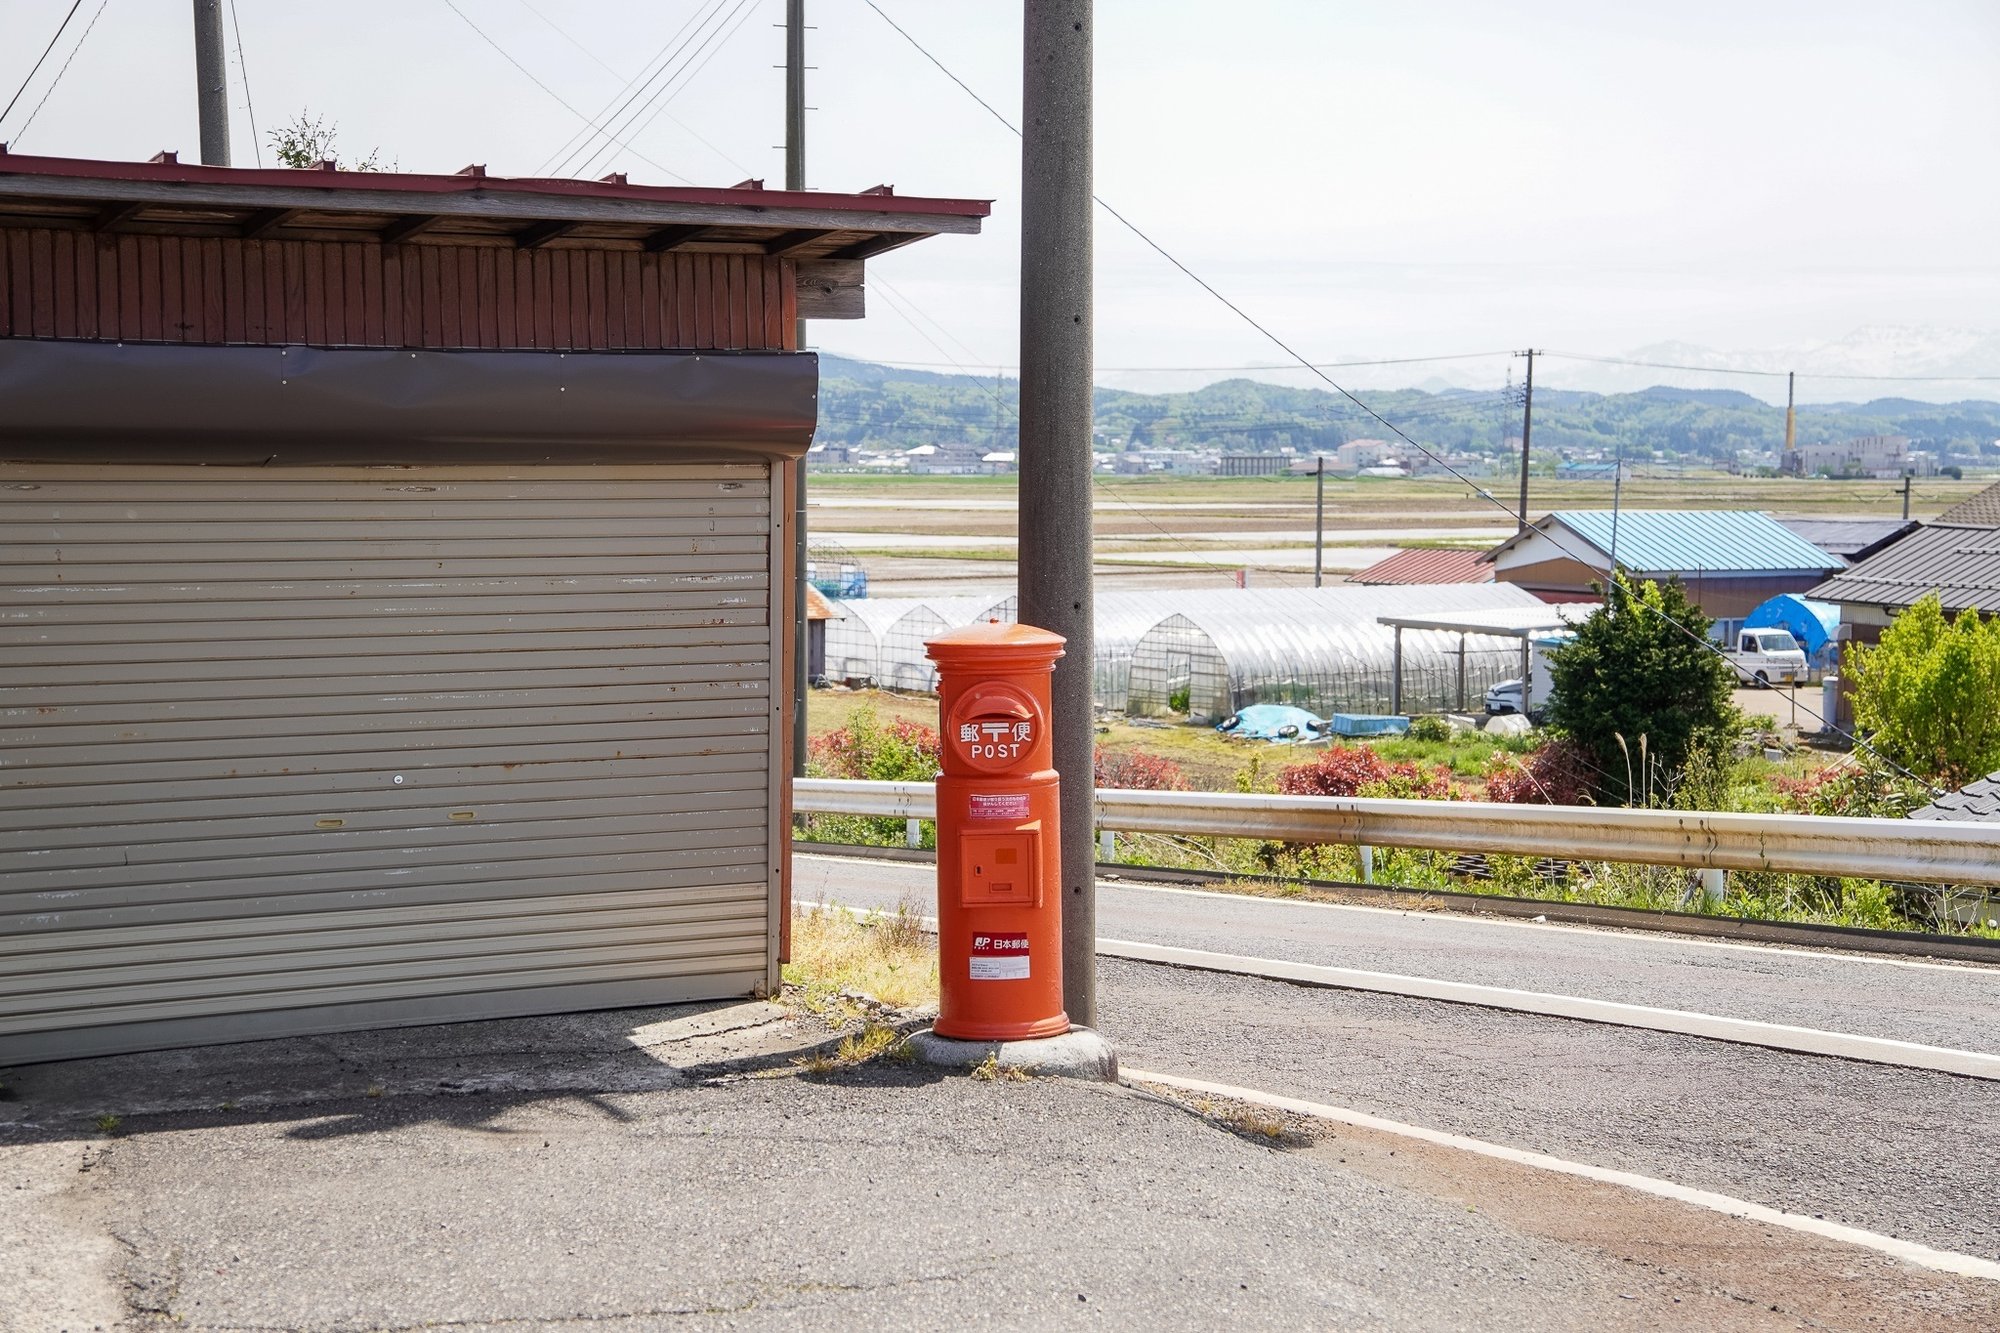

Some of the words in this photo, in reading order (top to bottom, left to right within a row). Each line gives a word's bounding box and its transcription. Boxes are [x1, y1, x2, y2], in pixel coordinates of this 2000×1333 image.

[971, 744, 1020, 759] POST
[993, 939, 1029, 949] 日本郵便
